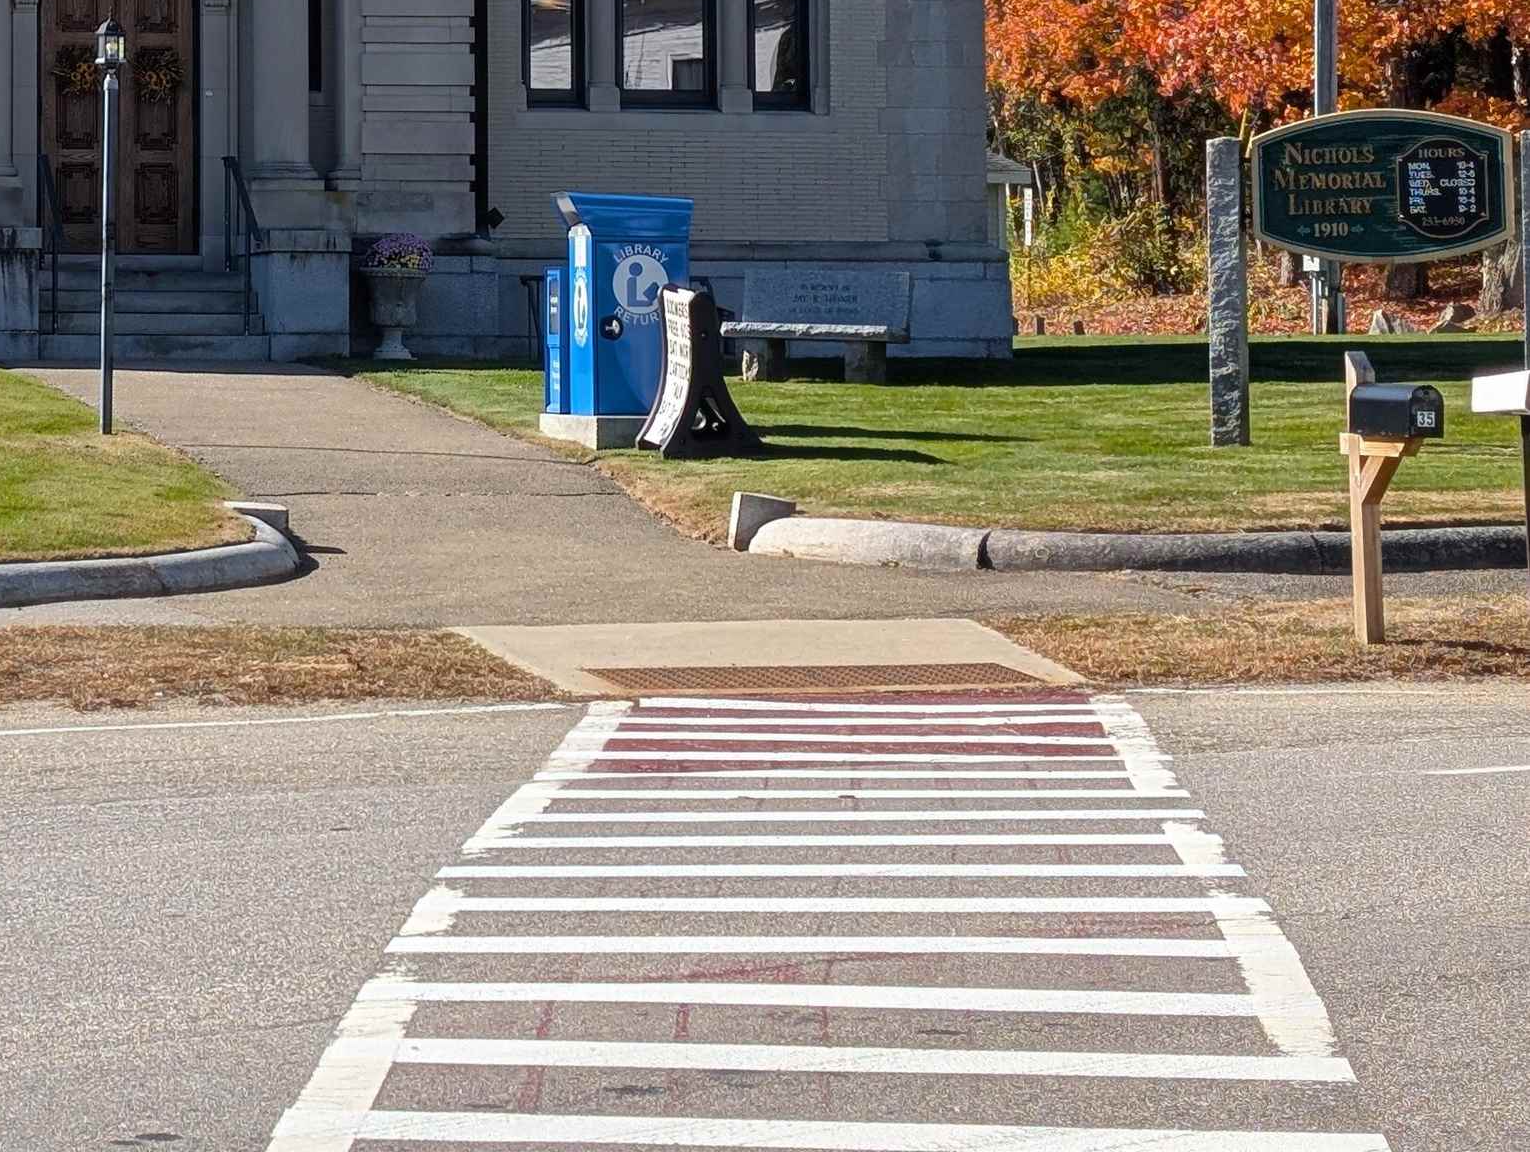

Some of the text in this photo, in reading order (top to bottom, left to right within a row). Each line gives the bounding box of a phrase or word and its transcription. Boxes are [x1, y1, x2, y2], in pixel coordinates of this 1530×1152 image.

[1418, 149, 1465, 159] HOURS
[1439, 178, 1476, 187] CLOSED
[1313, 222, 1350, 238] 1910
[613, 243, 669, 263] LIBRARY
[613, 306, 661, 326] RETUR
[1419, 412, 1434, 426] 35
